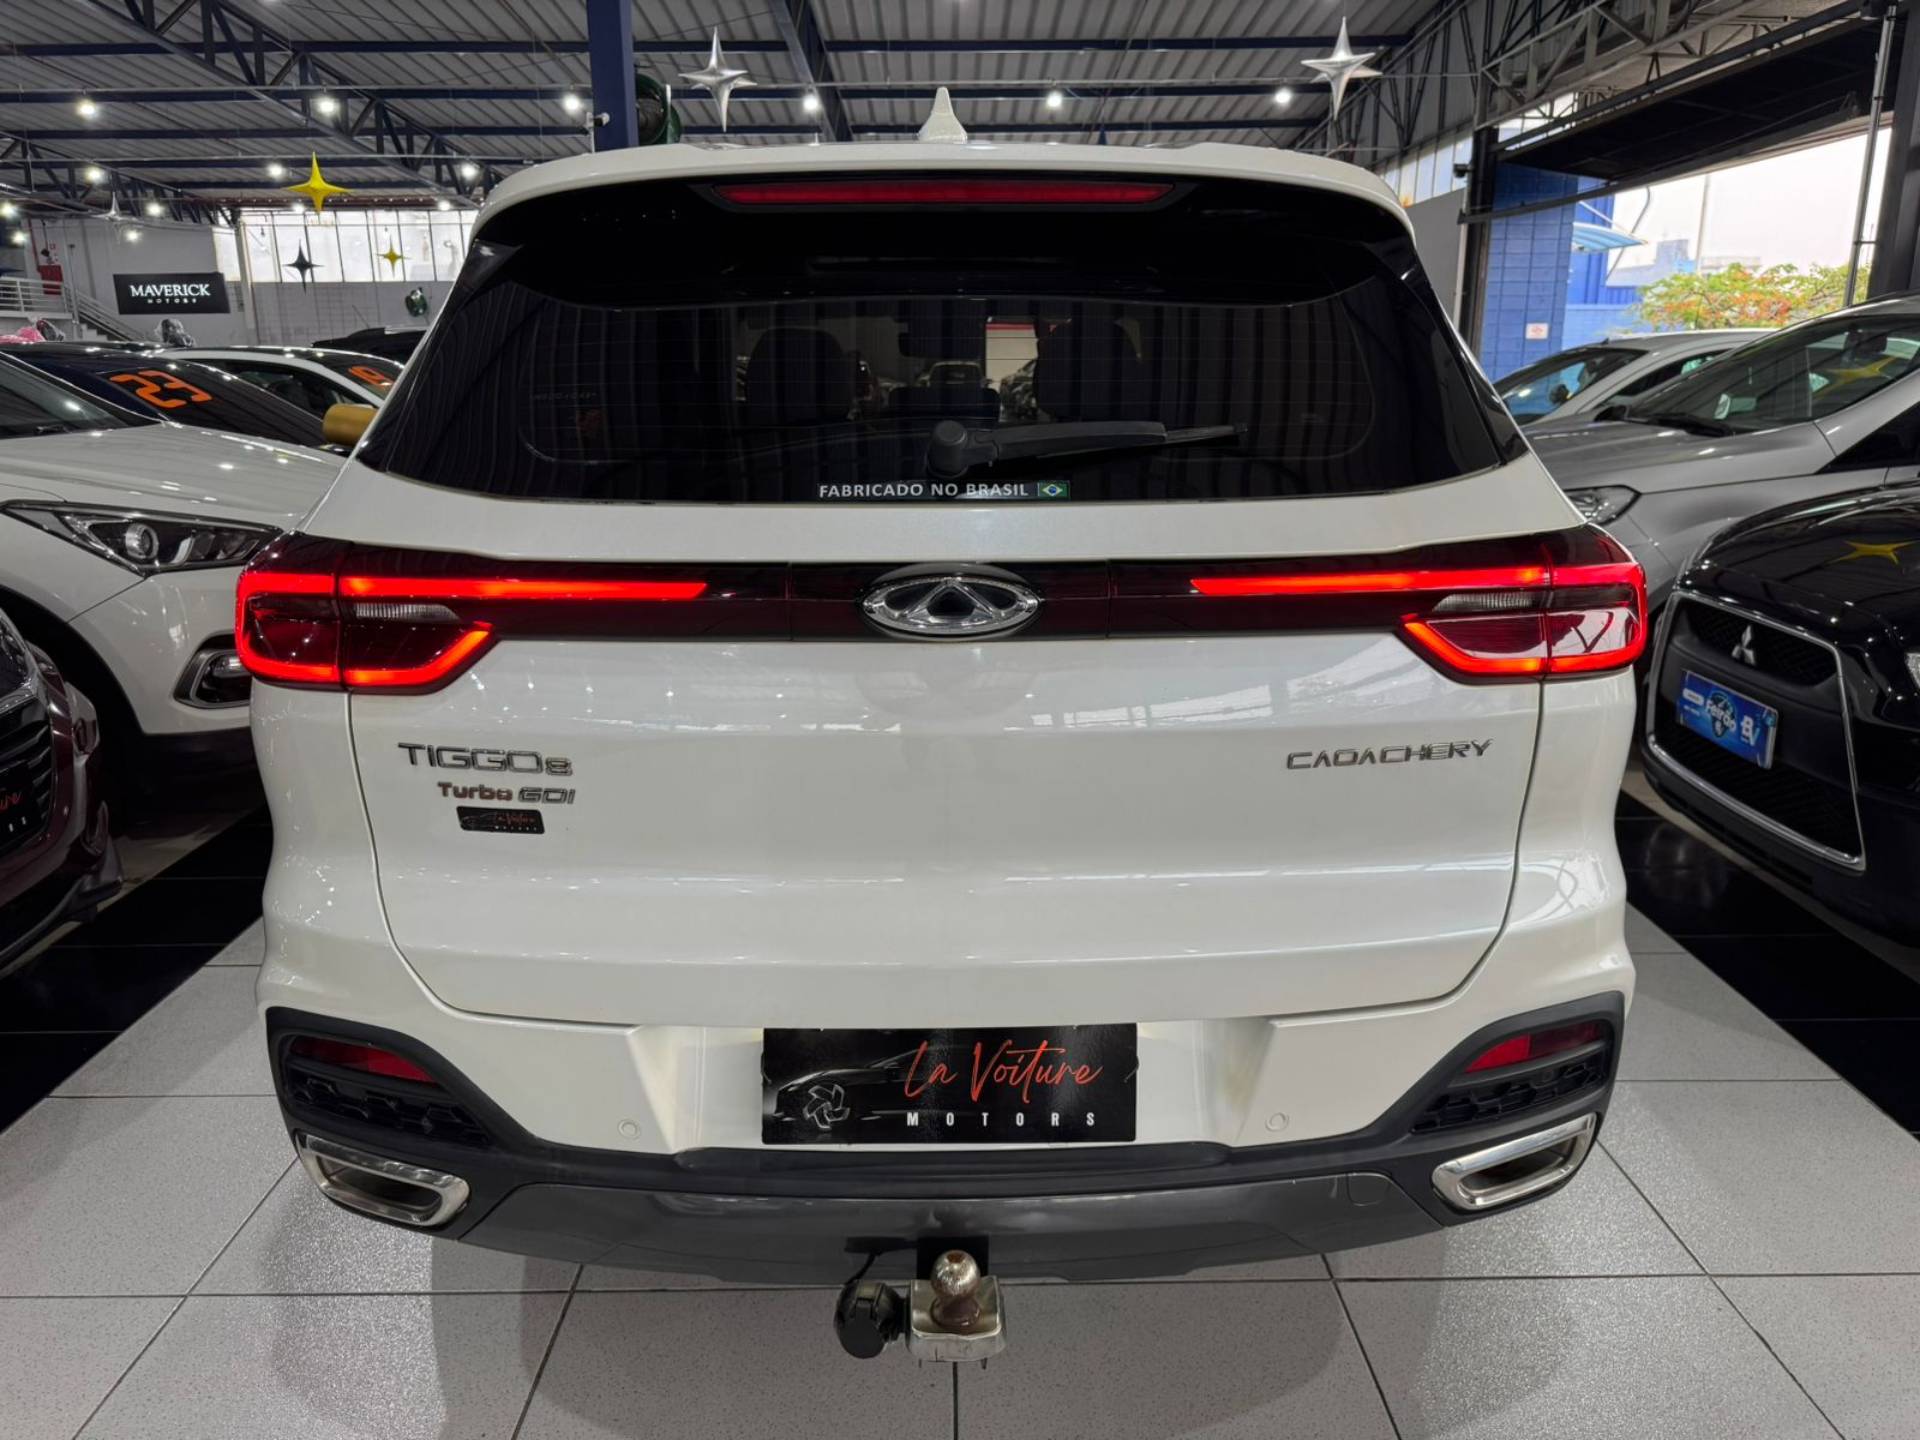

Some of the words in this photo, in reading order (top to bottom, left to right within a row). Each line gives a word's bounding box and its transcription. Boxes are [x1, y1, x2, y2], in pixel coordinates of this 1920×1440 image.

[129, 283, 211, 297] MAVERICK
[109, 369, 212, 408] 23
[819, 483, 924, 498] FABRICADO
[931, 483, 959, 496] NO
[966, 483, 1028, 496] BRASIL
[437, 782, 513, 801] Turbo
[518, 787, 576, 804] GDI
[904, 1040, 958, 1098] La
[971, 1039, 1104, 1104] Voiture
[907, 1111, 1095, 1127] MOTORS
